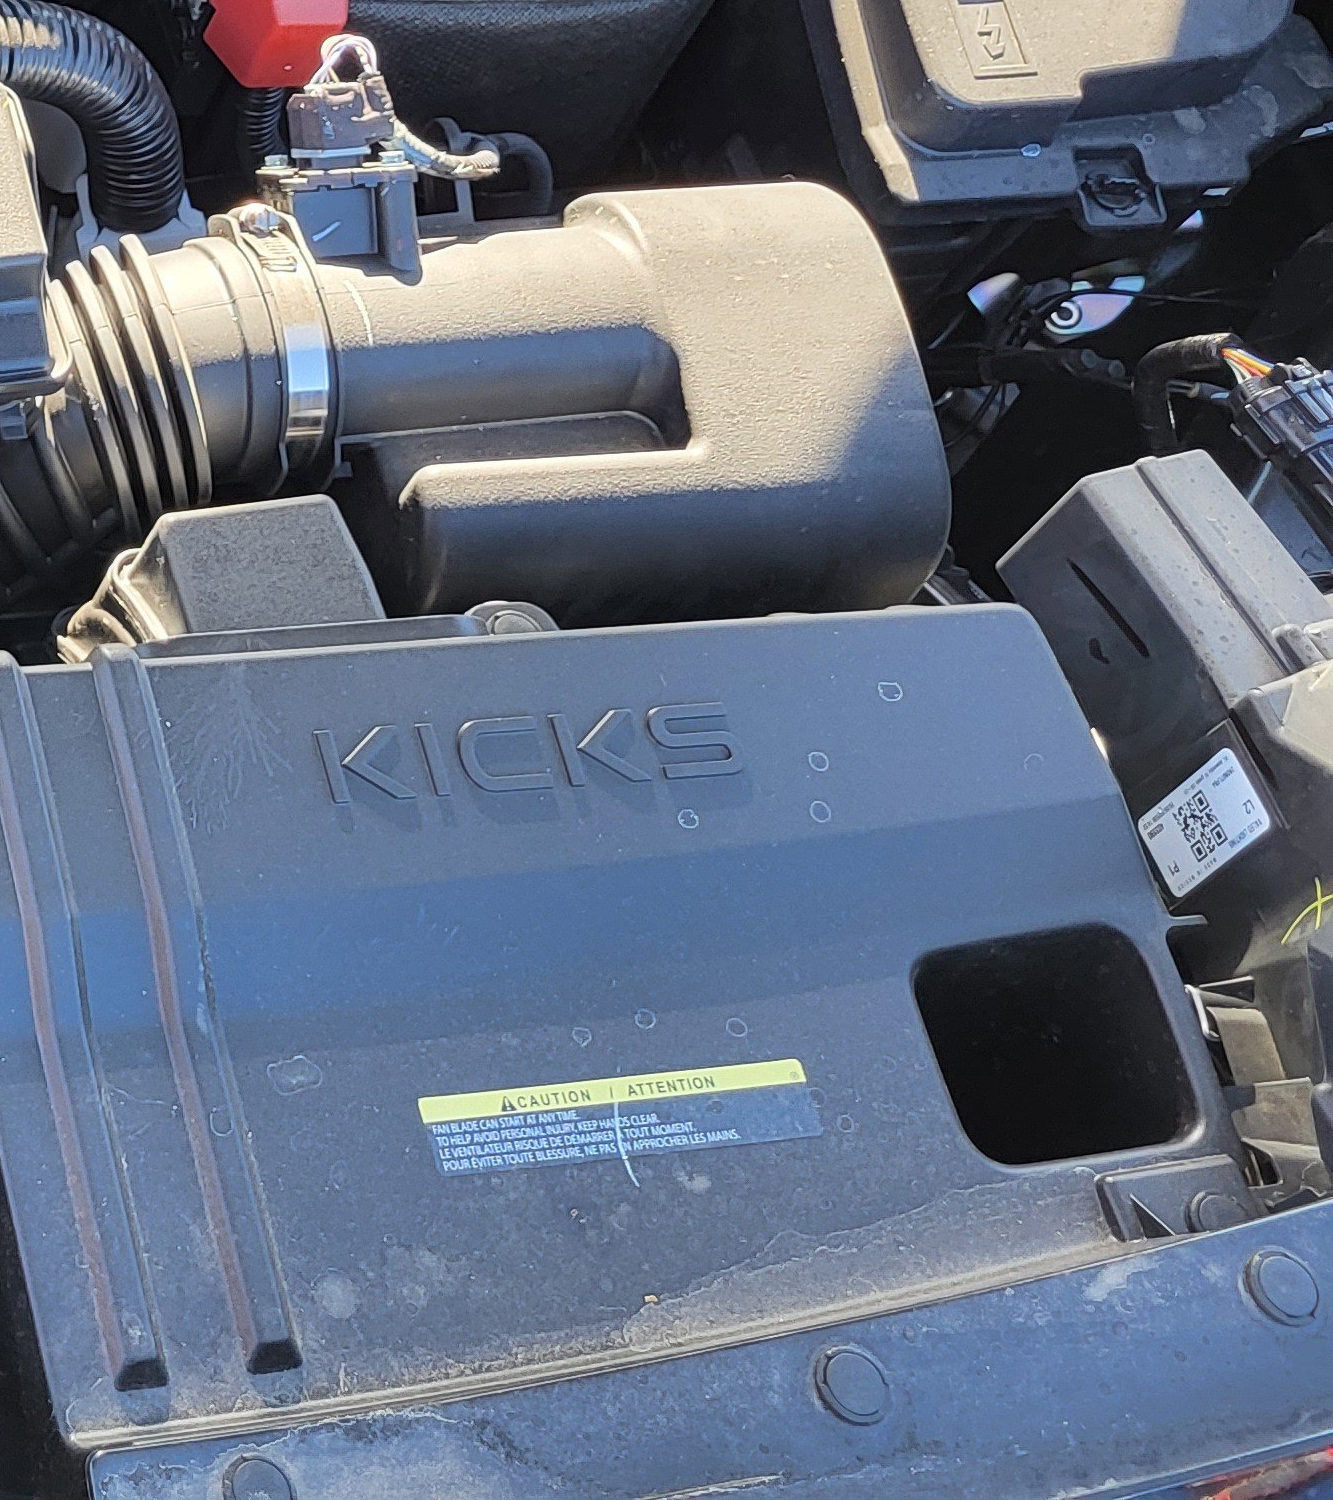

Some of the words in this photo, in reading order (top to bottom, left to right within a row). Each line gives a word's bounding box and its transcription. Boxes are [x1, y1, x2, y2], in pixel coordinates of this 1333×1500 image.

[311, 701, 743, 804] KICKS
[1241, 797, 1255, 815] L2
[1166, 859, 1180, 877] P1
[517, 1089, 591, 1109] CAUTION
[628, 1076, 716, 1097] ATTENTION
[432, 1123, 450, 1135] FAN
[451, 1122, 480, 1133] BLADE
[480, 1119, 499, 1130] CAN
[499, 1116, 525, 1128] START
[526, 1114, 537, 1125] AT
[538, 1113, 556, 1124] ANY
[436, 1136, 449, 1147] TO
[450, 1133, 472, 1145] HELP
[473, 1131, 501, 1143] AVOID
[501, 1127, 545, 1141] PERSONAL
[578, 1120, 599, 1132] KEEP
[439, 1148, 453, 1160] LE
[453, 1142, 514, 1158] VENTILATEUR
[514, 1138, 550, 1152] RISQUE
[550, 1135, 564, 1147] DE
[625, 1125, 652, 1138] TOUT
[443, 1159, 471, 1172] POUR
[504, 1152, 536, 1166] TOUTE
[585, 1145, 599, 1156] NE
[599, 1143, 618, 1155] PAS
[633, 1134, 690, 1150] APPROCHER
[690, 1133, 707, 1144] LES
